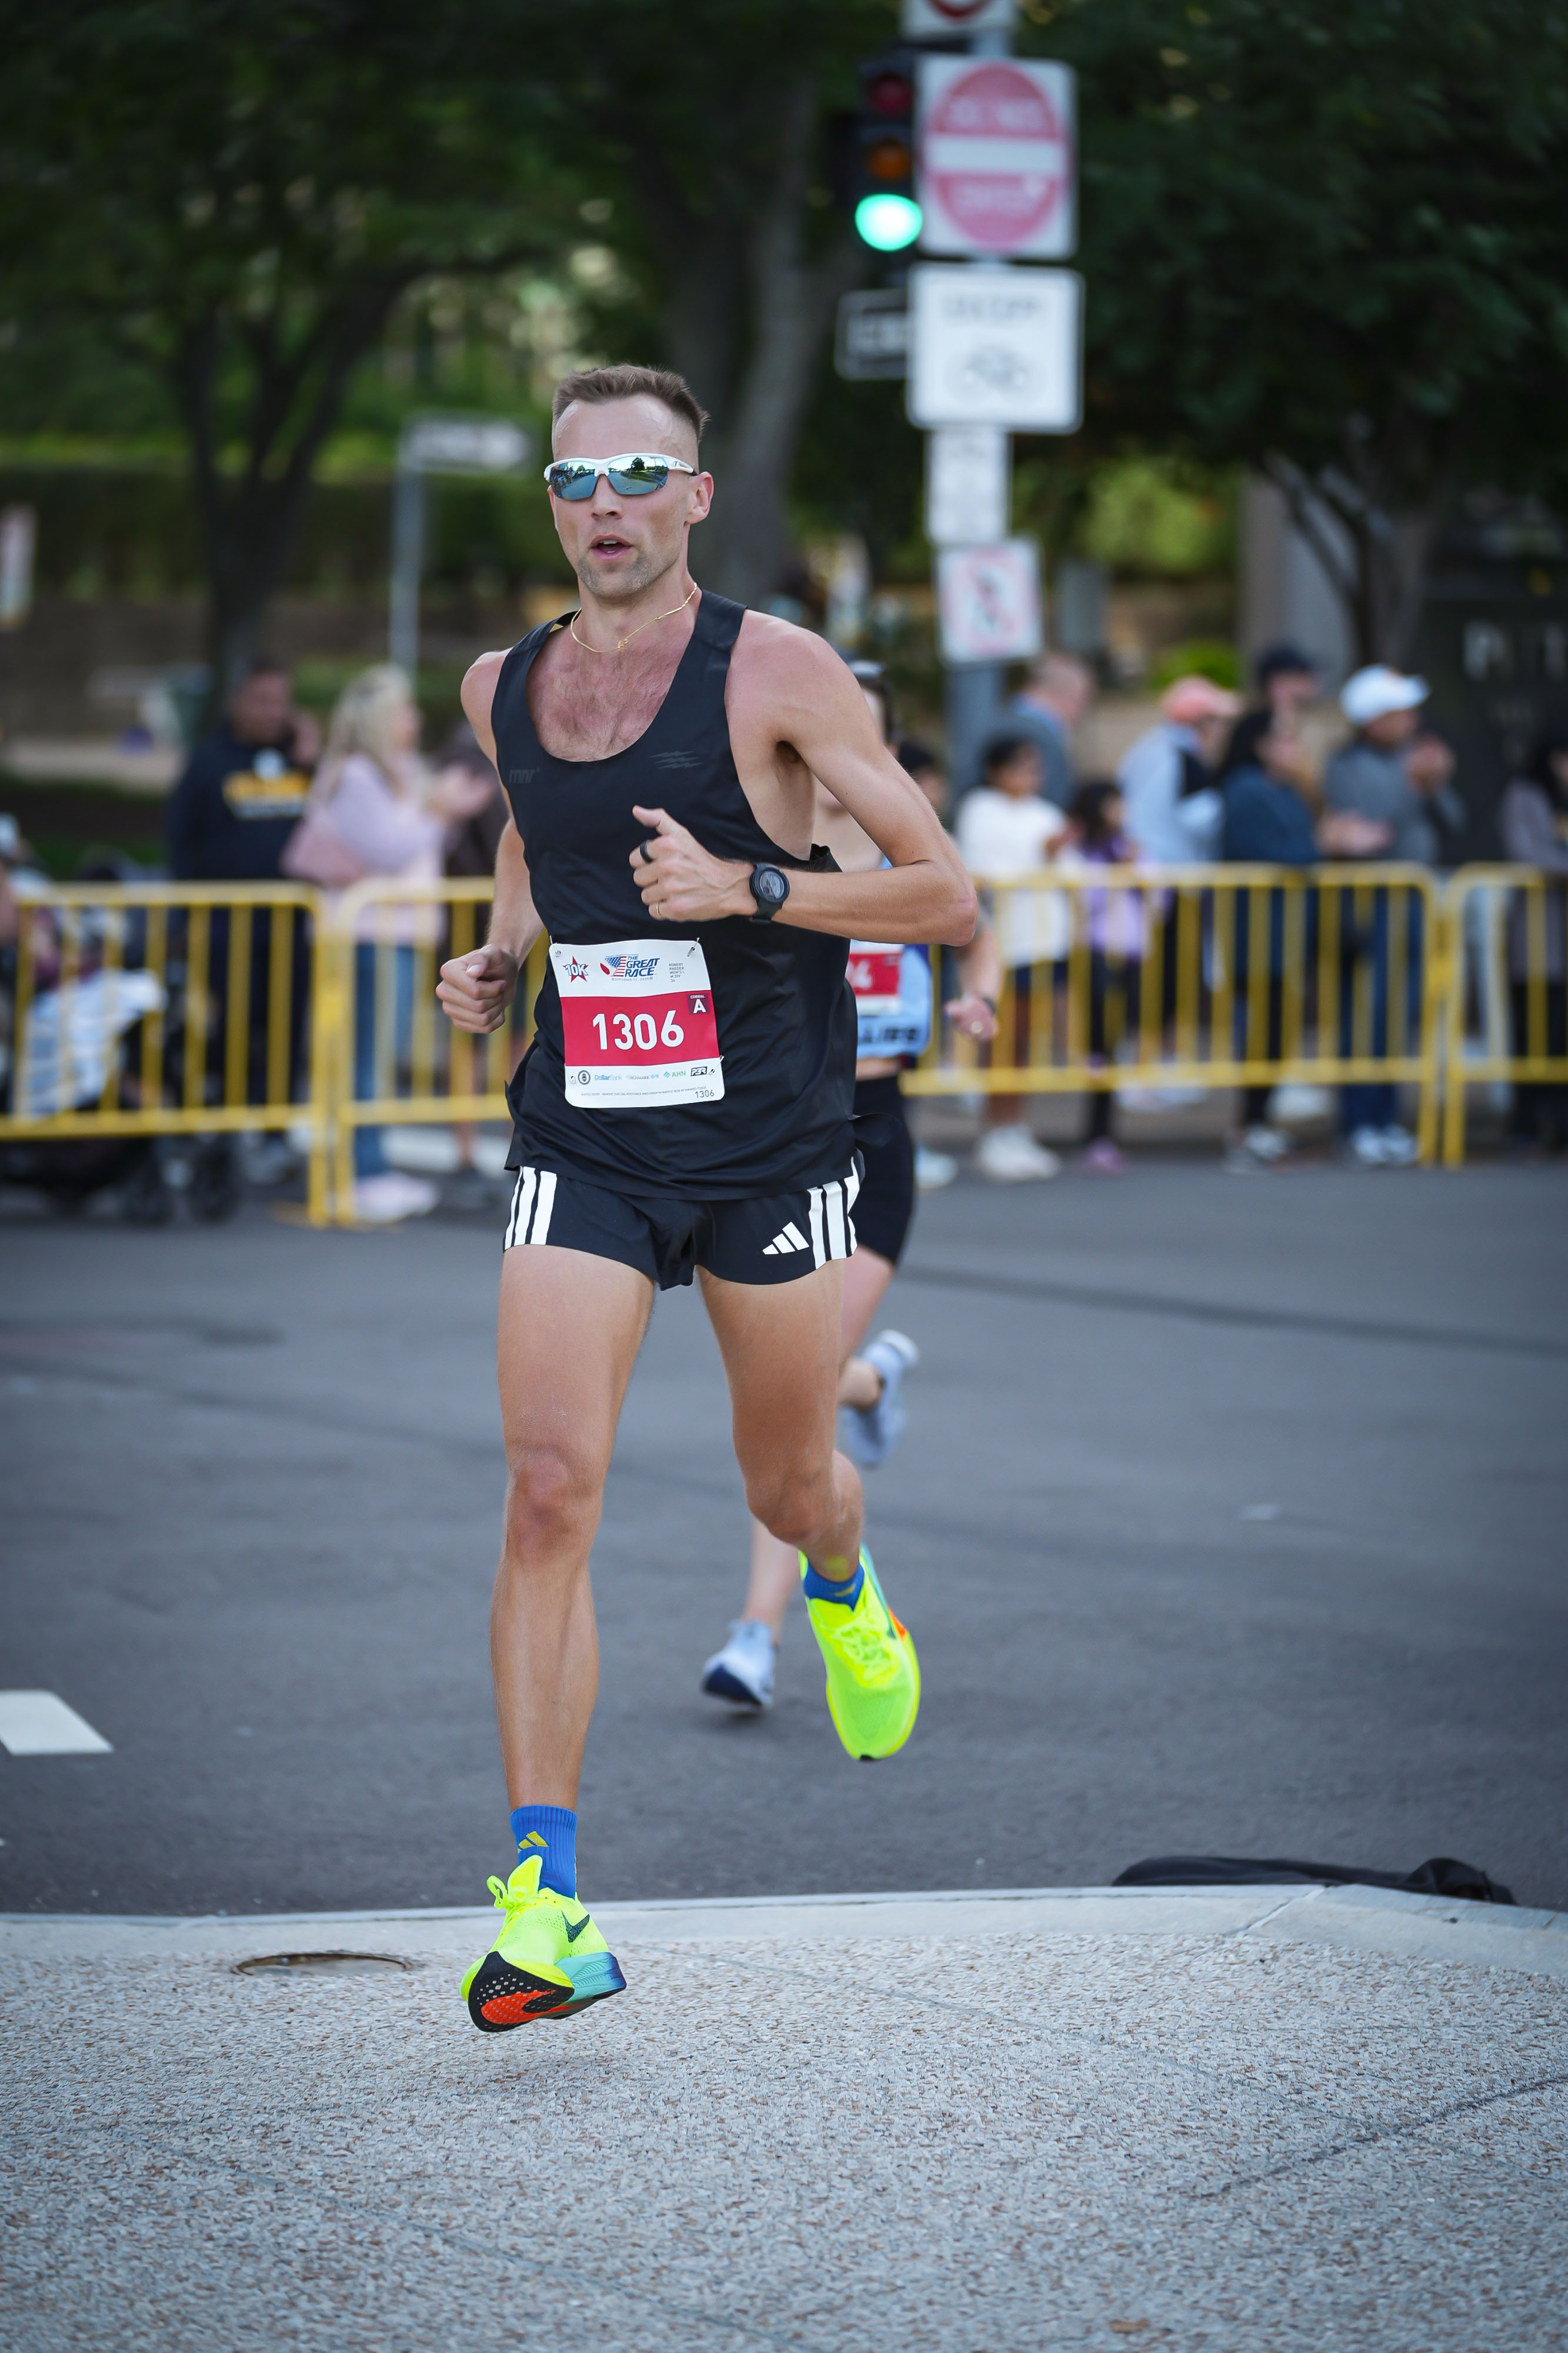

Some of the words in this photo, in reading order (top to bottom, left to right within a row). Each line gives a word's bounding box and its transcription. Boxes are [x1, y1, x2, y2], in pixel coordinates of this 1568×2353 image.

[626, 958, 660, 968] GREAT
[565, 964, 589, 976] 10K
[625, 967, 655, 977] RACE
[693, 999, 706, 1014] A
[592, 1009, 685, 1051] 1306
[695, 1089, 715, 1098] 1306
